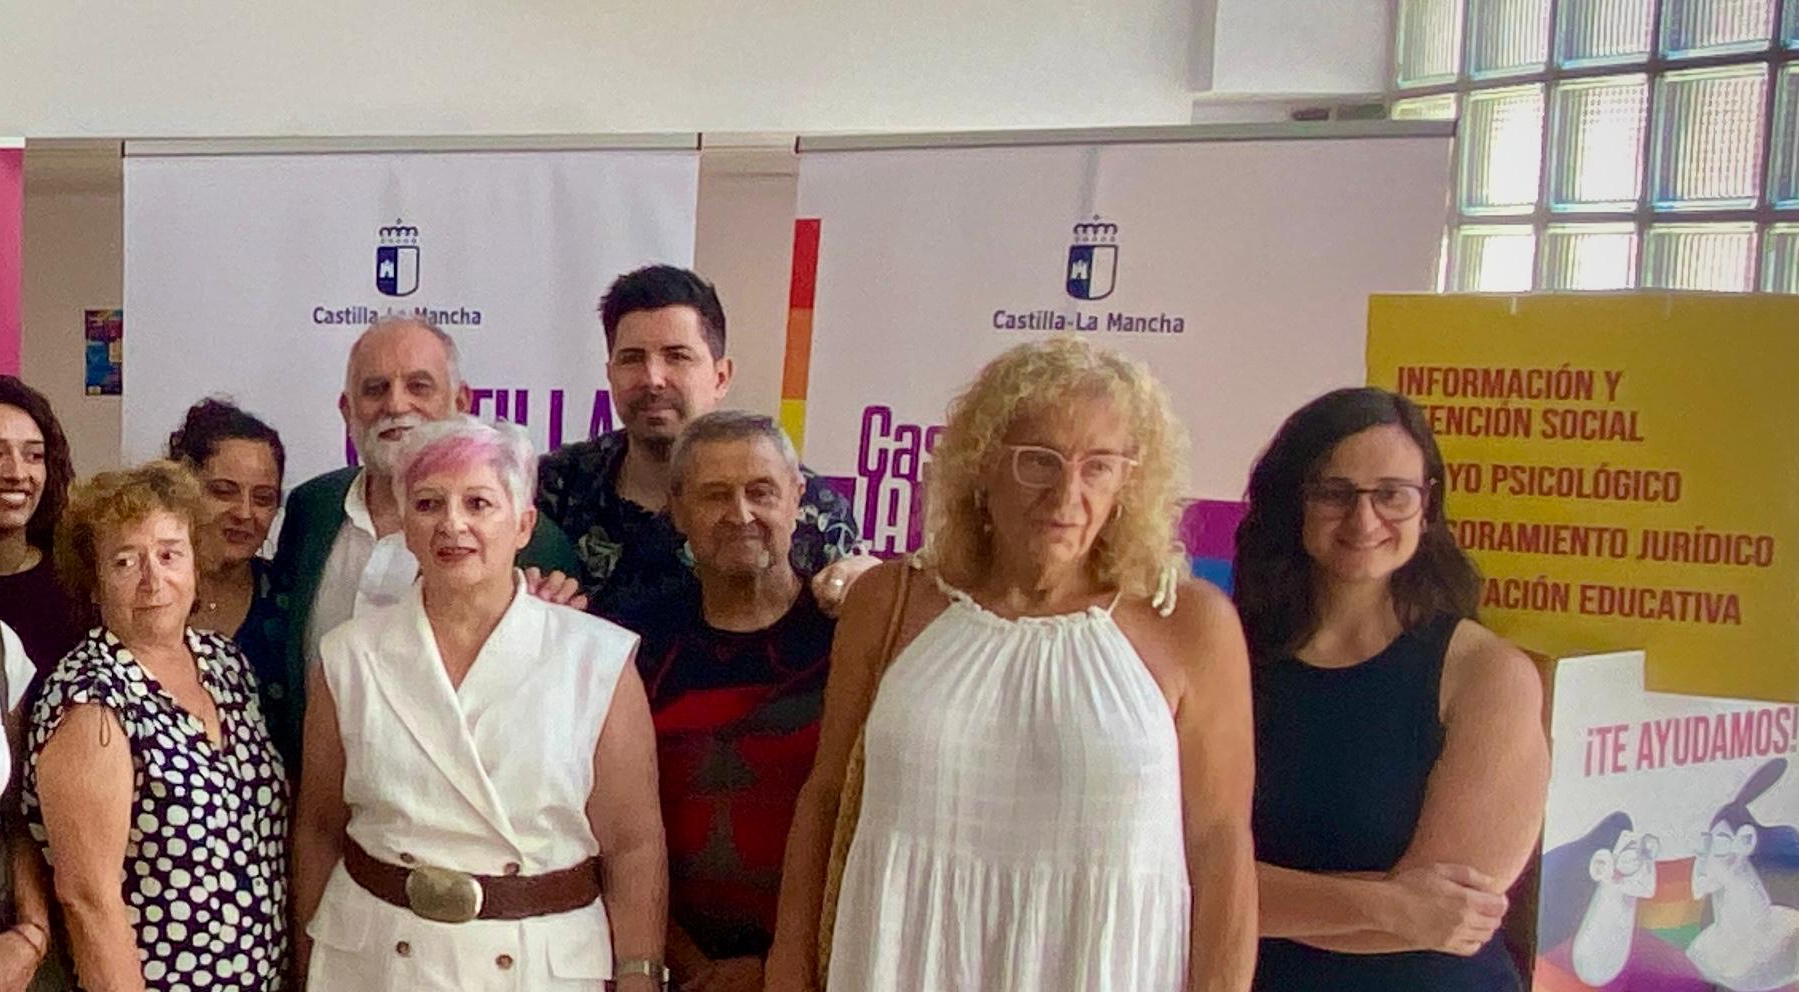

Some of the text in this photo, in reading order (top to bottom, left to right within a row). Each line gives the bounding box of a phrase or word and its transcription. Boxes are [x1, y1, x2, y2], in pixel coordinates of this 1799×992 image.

[993, 310, 1185, 333] Castilla-La Mancha
[1397, 363, 1623, 402] INFORMACIÓN Y
[1419, 402, 1644, 442] ENCIÓN SOCIAL
[1491, 461, 1682, 502] PSICOLÓGICO
[1449, 520, 1776, 567] ORAMIENTO JURÍDICO
[1578, 583, 1741, 625] EDUCATIVA
[1584, 706, 1799, 777] ¡TE AYUDAMOS!
